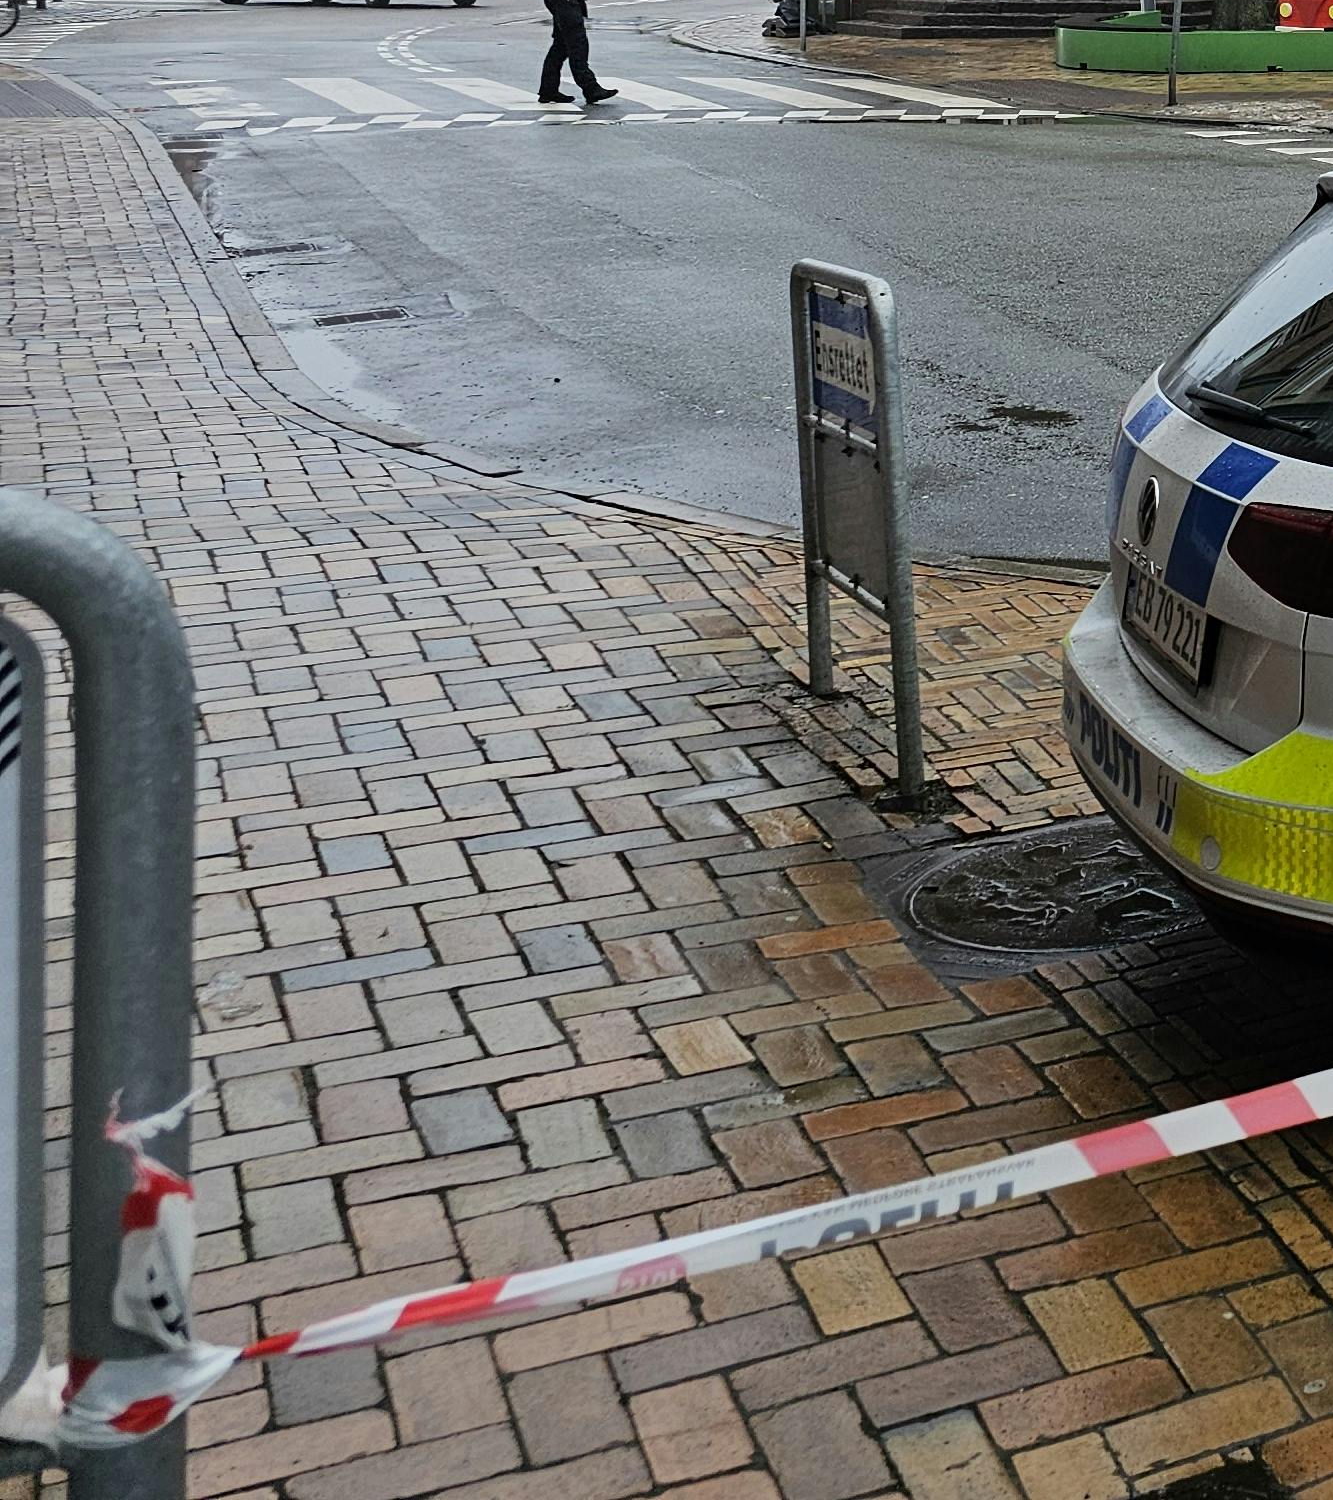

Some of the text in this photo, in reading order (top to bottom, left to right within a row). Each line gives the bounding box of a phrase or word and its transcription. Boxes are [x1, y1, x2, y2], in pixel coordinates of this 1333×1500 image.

[1135, 573, 1201, 670] EB 79 221
[1079, 690, 1142, 809] POLITI
